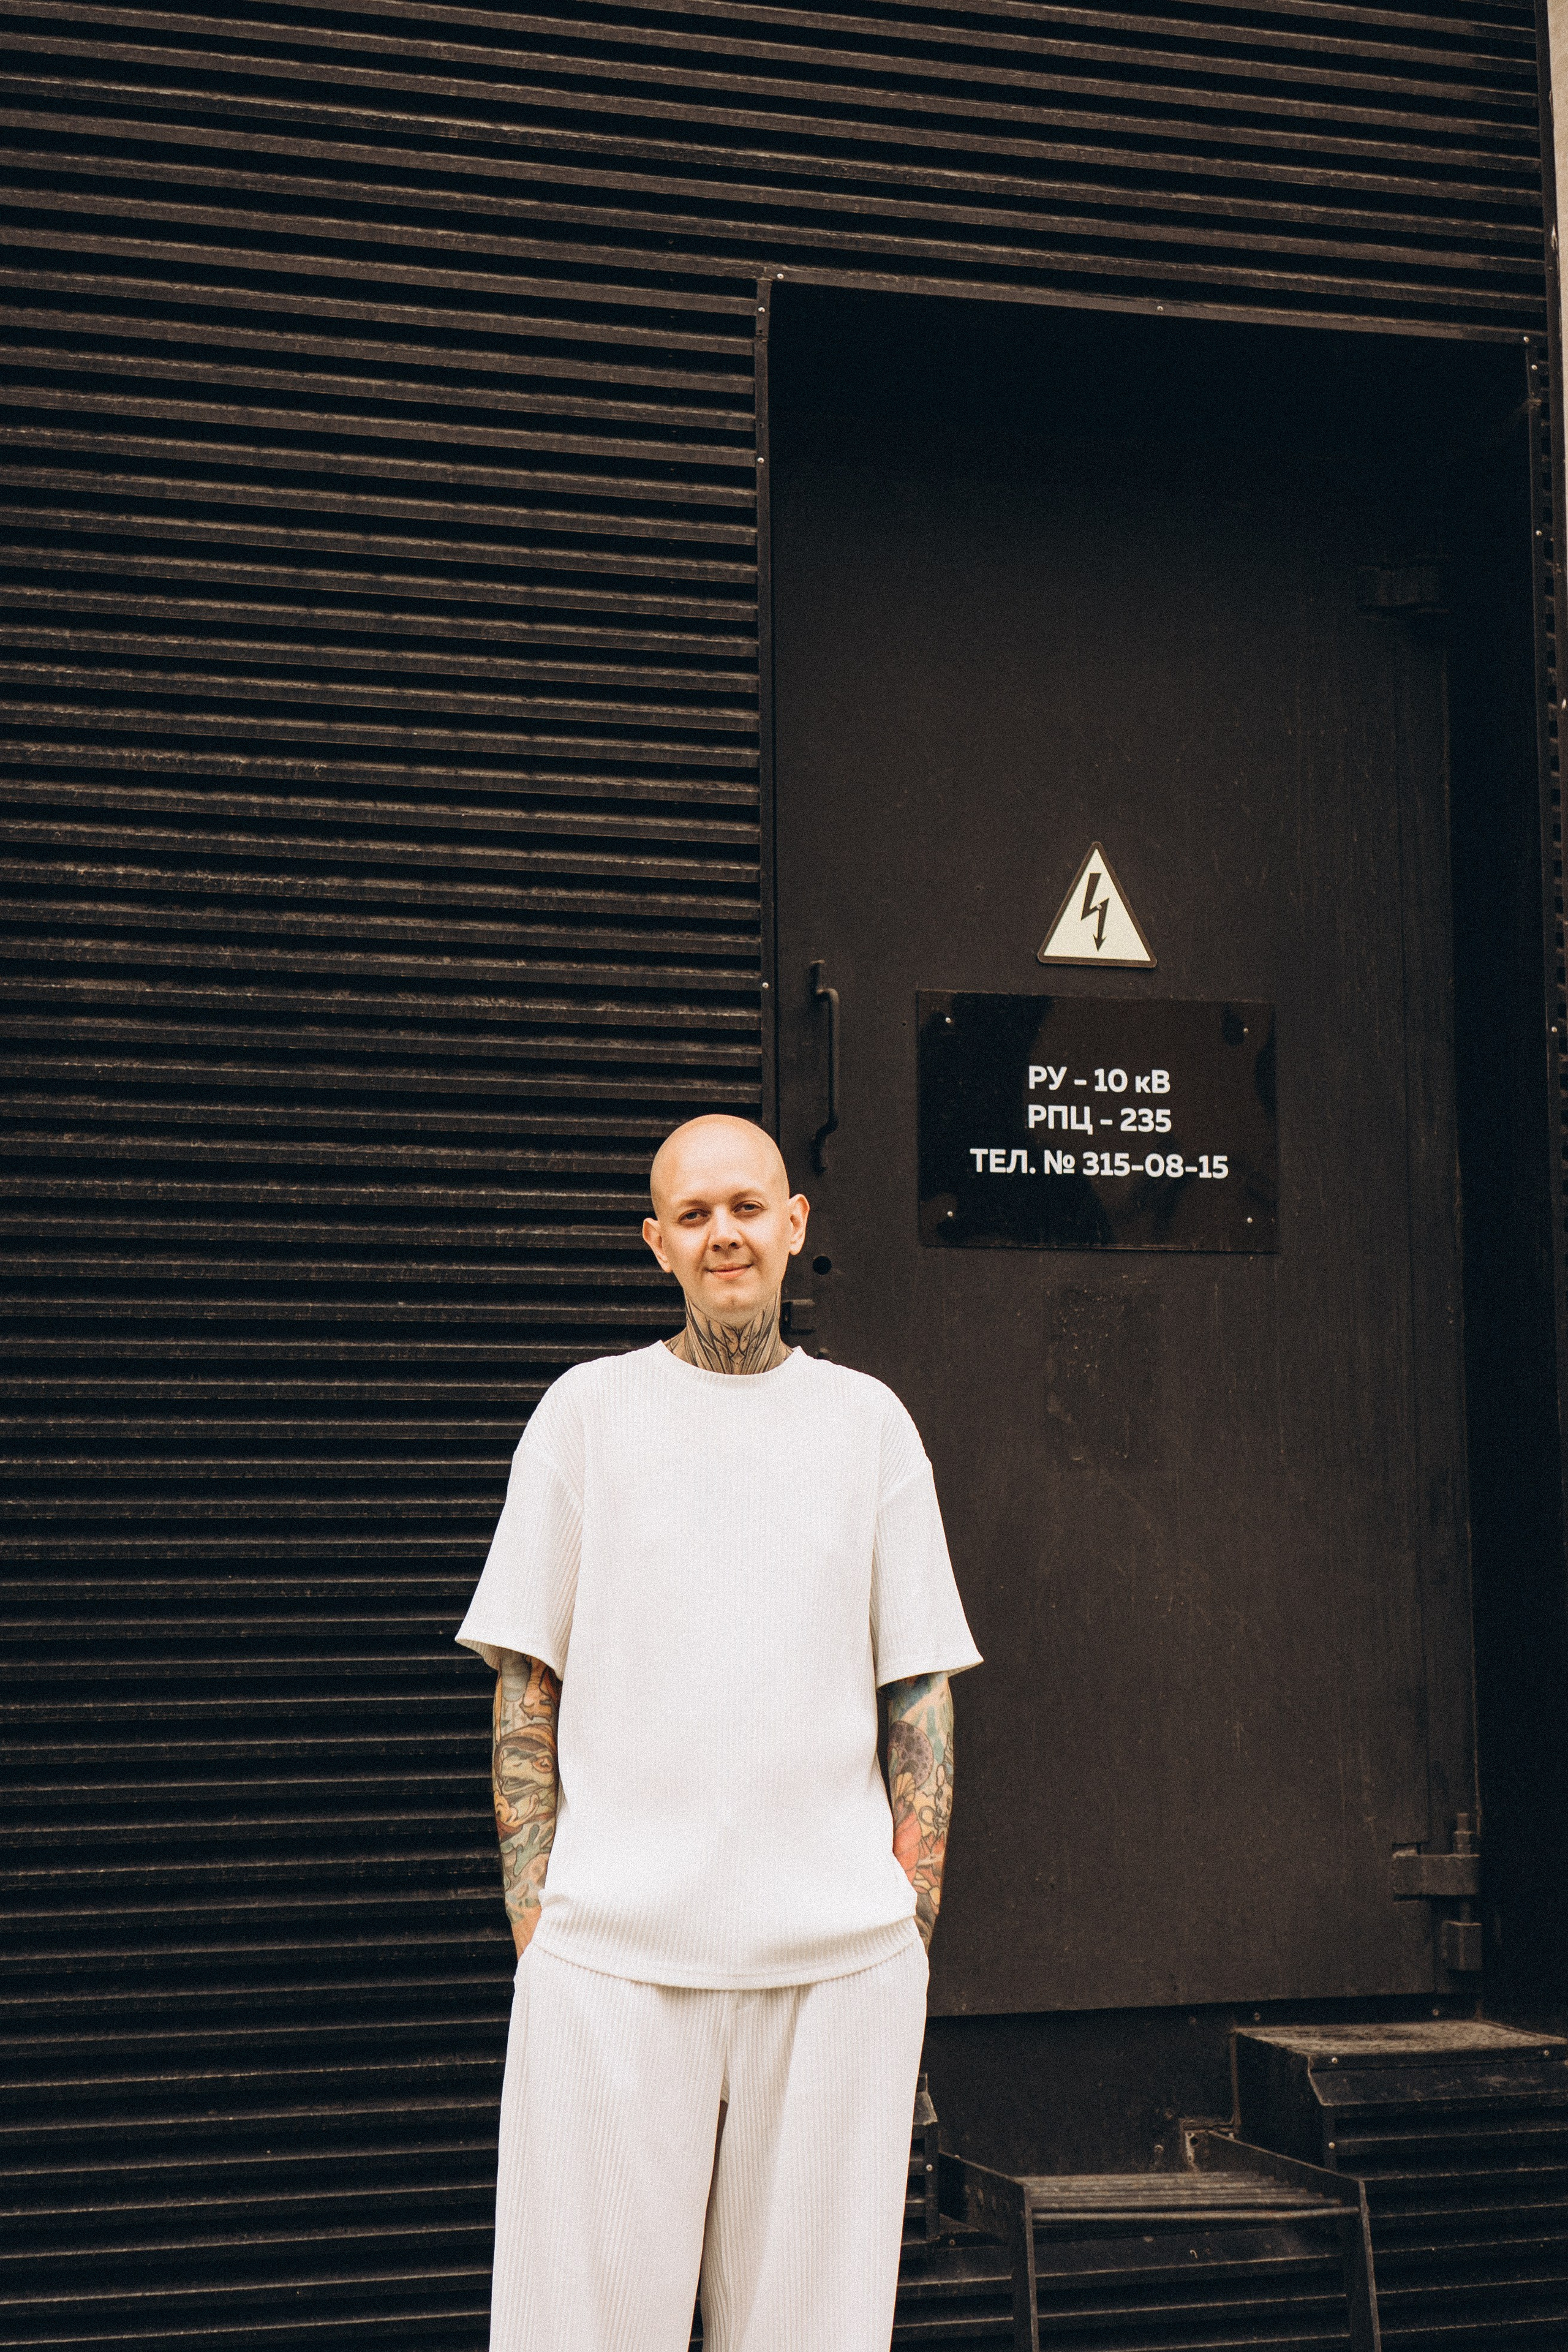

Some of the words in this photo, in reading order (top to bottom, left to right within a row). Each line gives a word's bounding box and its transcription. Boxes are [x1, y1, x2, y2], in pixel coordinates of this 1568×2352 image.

[1028, 1065, 1068, 1091] РУ
[1094, 1068, 1128, 1093] 10
[1135, 1069, 1170, 1094] кВ
[1028, 1104, 1093, 1136] РПЦ
[1120, 1107, 1172, 1133] 235
[969, 1148, 1036, 1174] ТЕЛ.
[1082, 1151, 1229, 1179] 315-08-15
